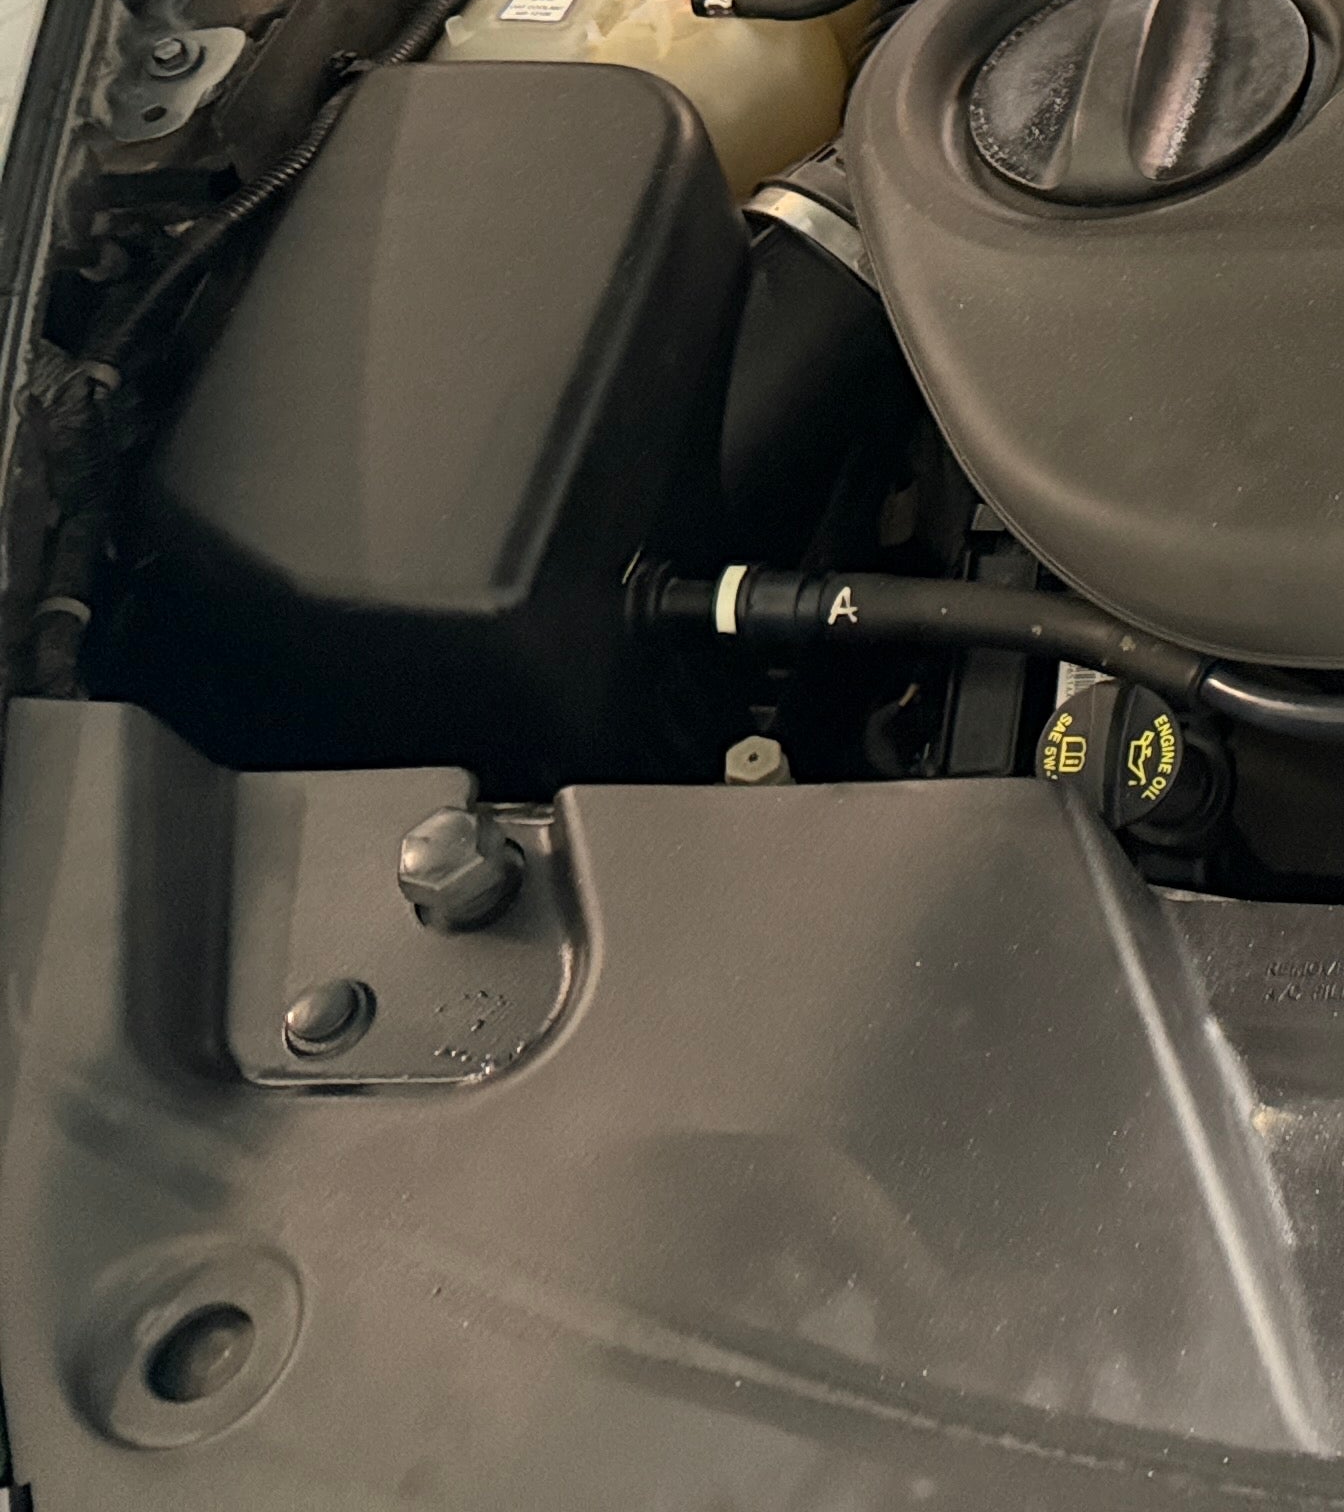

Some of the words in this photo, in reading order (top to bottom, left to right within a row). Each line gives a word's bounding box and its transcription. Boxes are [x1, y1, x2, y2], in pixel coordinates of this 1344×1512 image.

[827, 586, 858, 625] A
[1048, 713, 1073, 744] SAE
[1154, 714, 1175, 775] ENGINE
[1141, 775, 1167, 801] OIL
